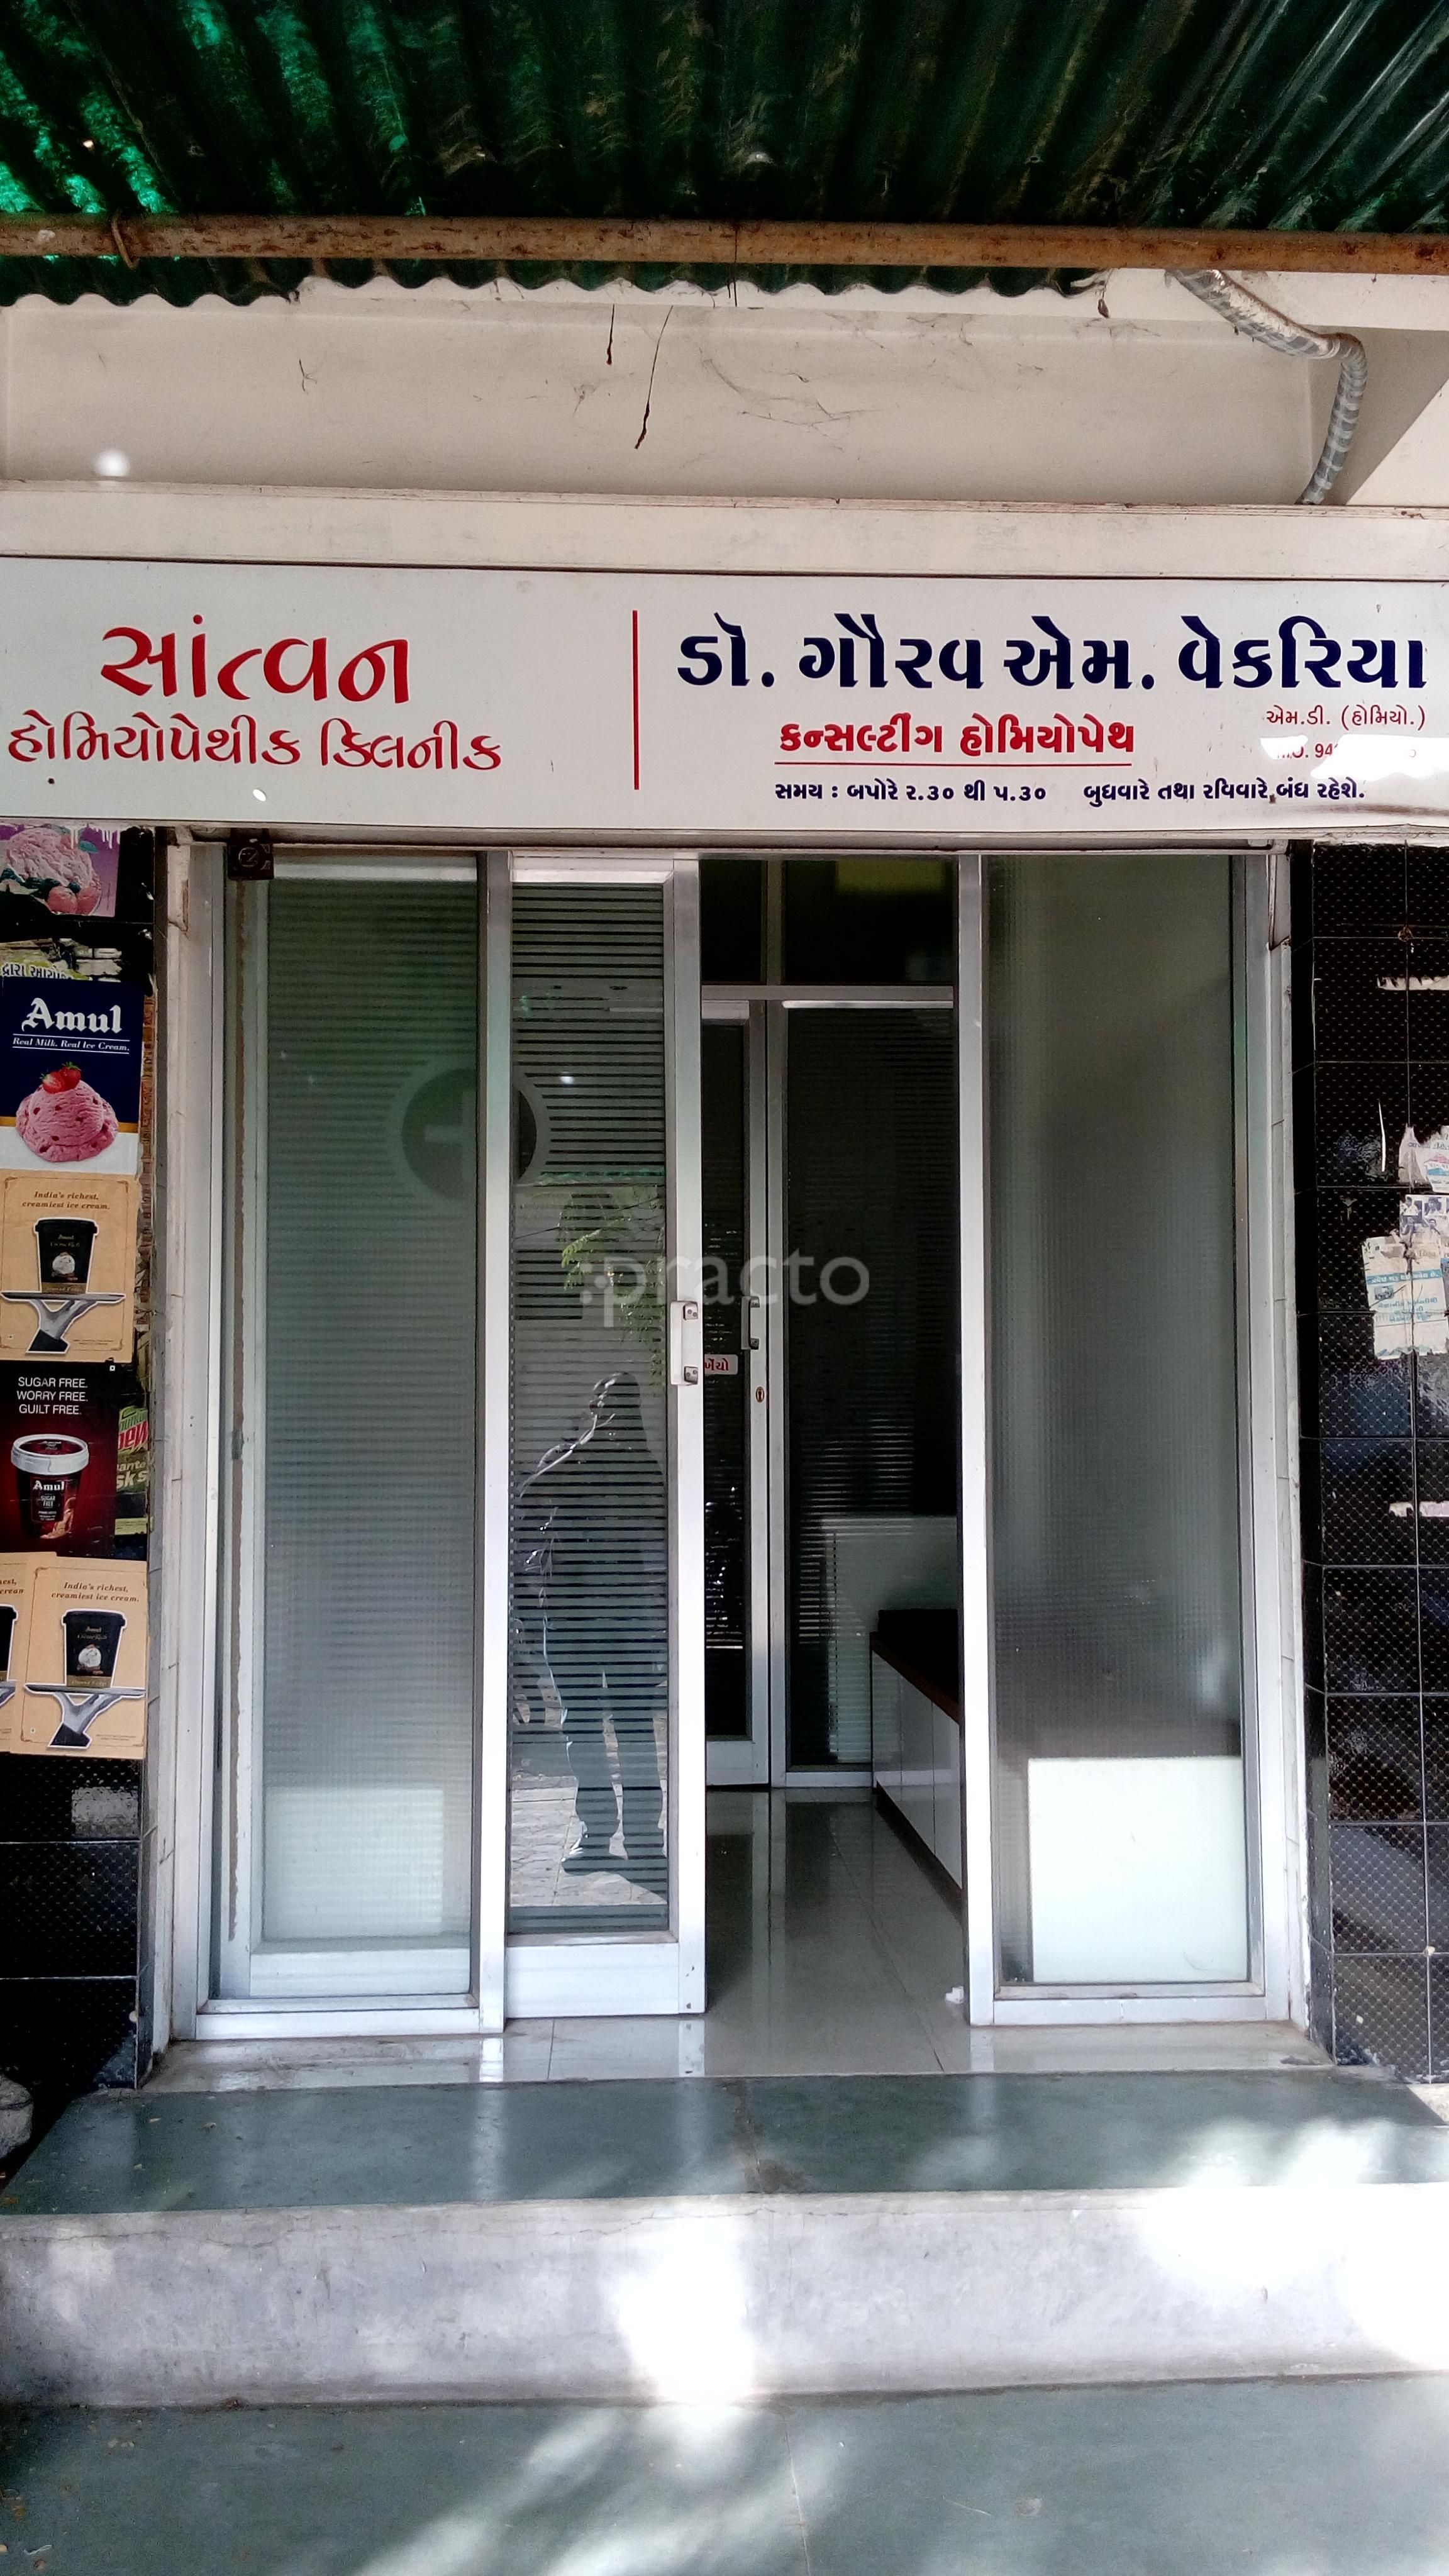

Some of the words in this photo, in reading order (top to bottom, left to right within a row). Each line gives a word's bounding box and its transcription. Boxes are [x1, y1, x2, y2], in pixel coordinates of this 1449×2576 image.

[101, 614, 409, 704] સાંત્વન
[798, 613, 984, 689] ગૌરવ
[1003, 616, 1155, 690] એમ.
[1178, 615, 1428, 689] વેકરિયા
[1267, 704, 1331, 725] એમ.ડી.
[1341, 704, 1426, 731] (હોમિયો.)
[8, 709, 301, 765] હોમિયોપેથીક
[321, 718, 501, 770] ક્લિનીક
[960, 712, 1134, 757] હોમિયોપેથ
[775, 784, 823, 799] સમય
[847, 778, 899, 801] બપોરે
[963, 780, 985, 801] થી
[1083, 778, 1150, 808] બુધવારે
[1157, 782, 1195, 799] તથા
[1202, 777, 1269, 799] રવિવારે
[1276, 777, 1309, 799] બંધ
[1317, 777, 1365, 800] રહેશે.
[21, 997, 123, 1034] Amul
[13, 1037, 33, 1046] Real
[35, 1038, 58, 1047] Milk.
[60, 1040, 81, 1048] Real
[82, 1041, 96, 1049] Ice
[98, 1042, 130, 1051] Cream.
[18, 1377, 55, 1387] SUGAR
[58, 1378, 88, 1388] FREE.
[16, 1391, 56, 1401] WORRY
[58, 1392, 88, 1402] FREE.
[19, 1404, 50, 1414] GUILT
[53, 1405, 82, 1415] FREE.
[33, 1480, 65, 1491] Amul
[64, 1582, 94, 1591] India's
